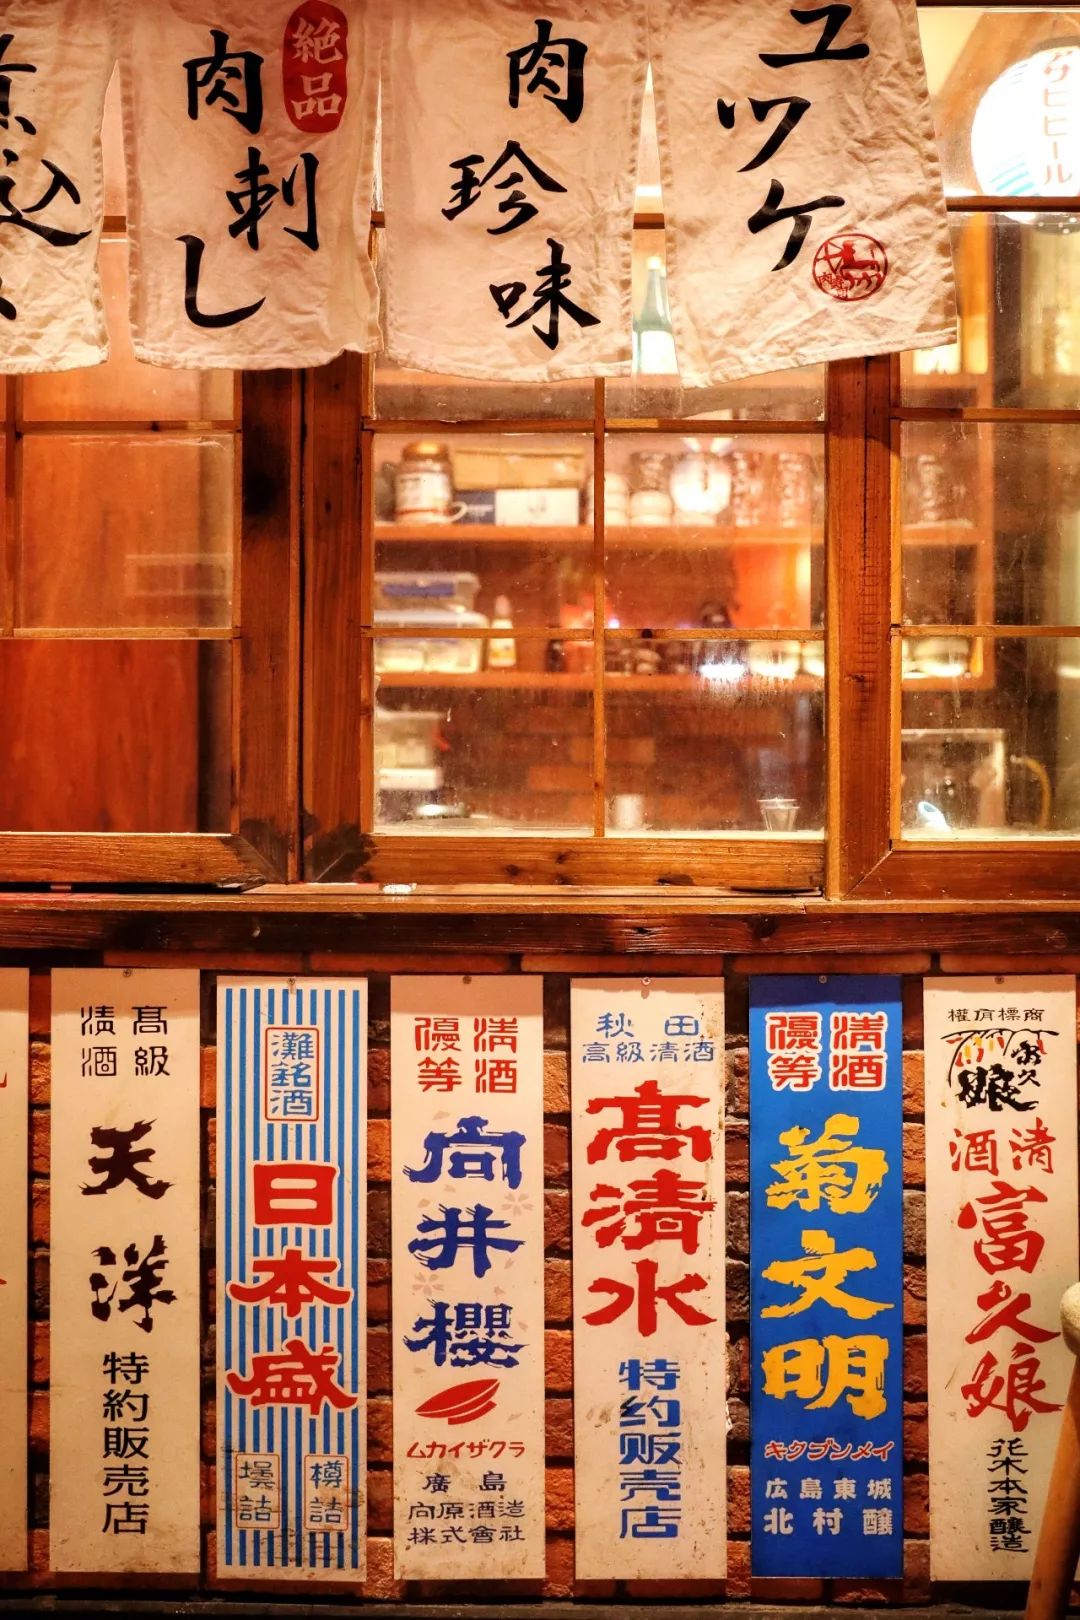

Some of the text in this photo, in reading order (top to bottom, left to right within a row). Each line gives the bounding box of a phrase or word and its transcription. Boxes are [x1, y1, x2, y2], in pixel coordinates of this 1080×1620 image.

[290, 17, 343, 118] 絶品
[176, 30, 320, 328] 肉刺し
[441, 18, 601, 350] 肉珍味
[414, 1017, 462, 1093] 優等
[473, 1017, 519, 1094] 清酒
[582, 1041, 716, 1063] 高級清酒
[596, 1012, 700, 1039] 秋田
[768, 1015, 820, 1088] 優等
[833, 1015, 884, 1088] 清酒
[270, 1032, 315, 1116] 灘銘酒
[227, 1164, 358, 1416] 日本盛
[761, 1113, 894, 1420] 菊文明
[102, 1351, 149, 1535] 特約販売店
[406, 1439, 526, 1459] ムカイザクラ
[764, 1437, 895, 1461] キクブンメイ
[408, 1500, 526, 1520] 向原酒造
[765, 1477, 892, 1500] 広島東城
